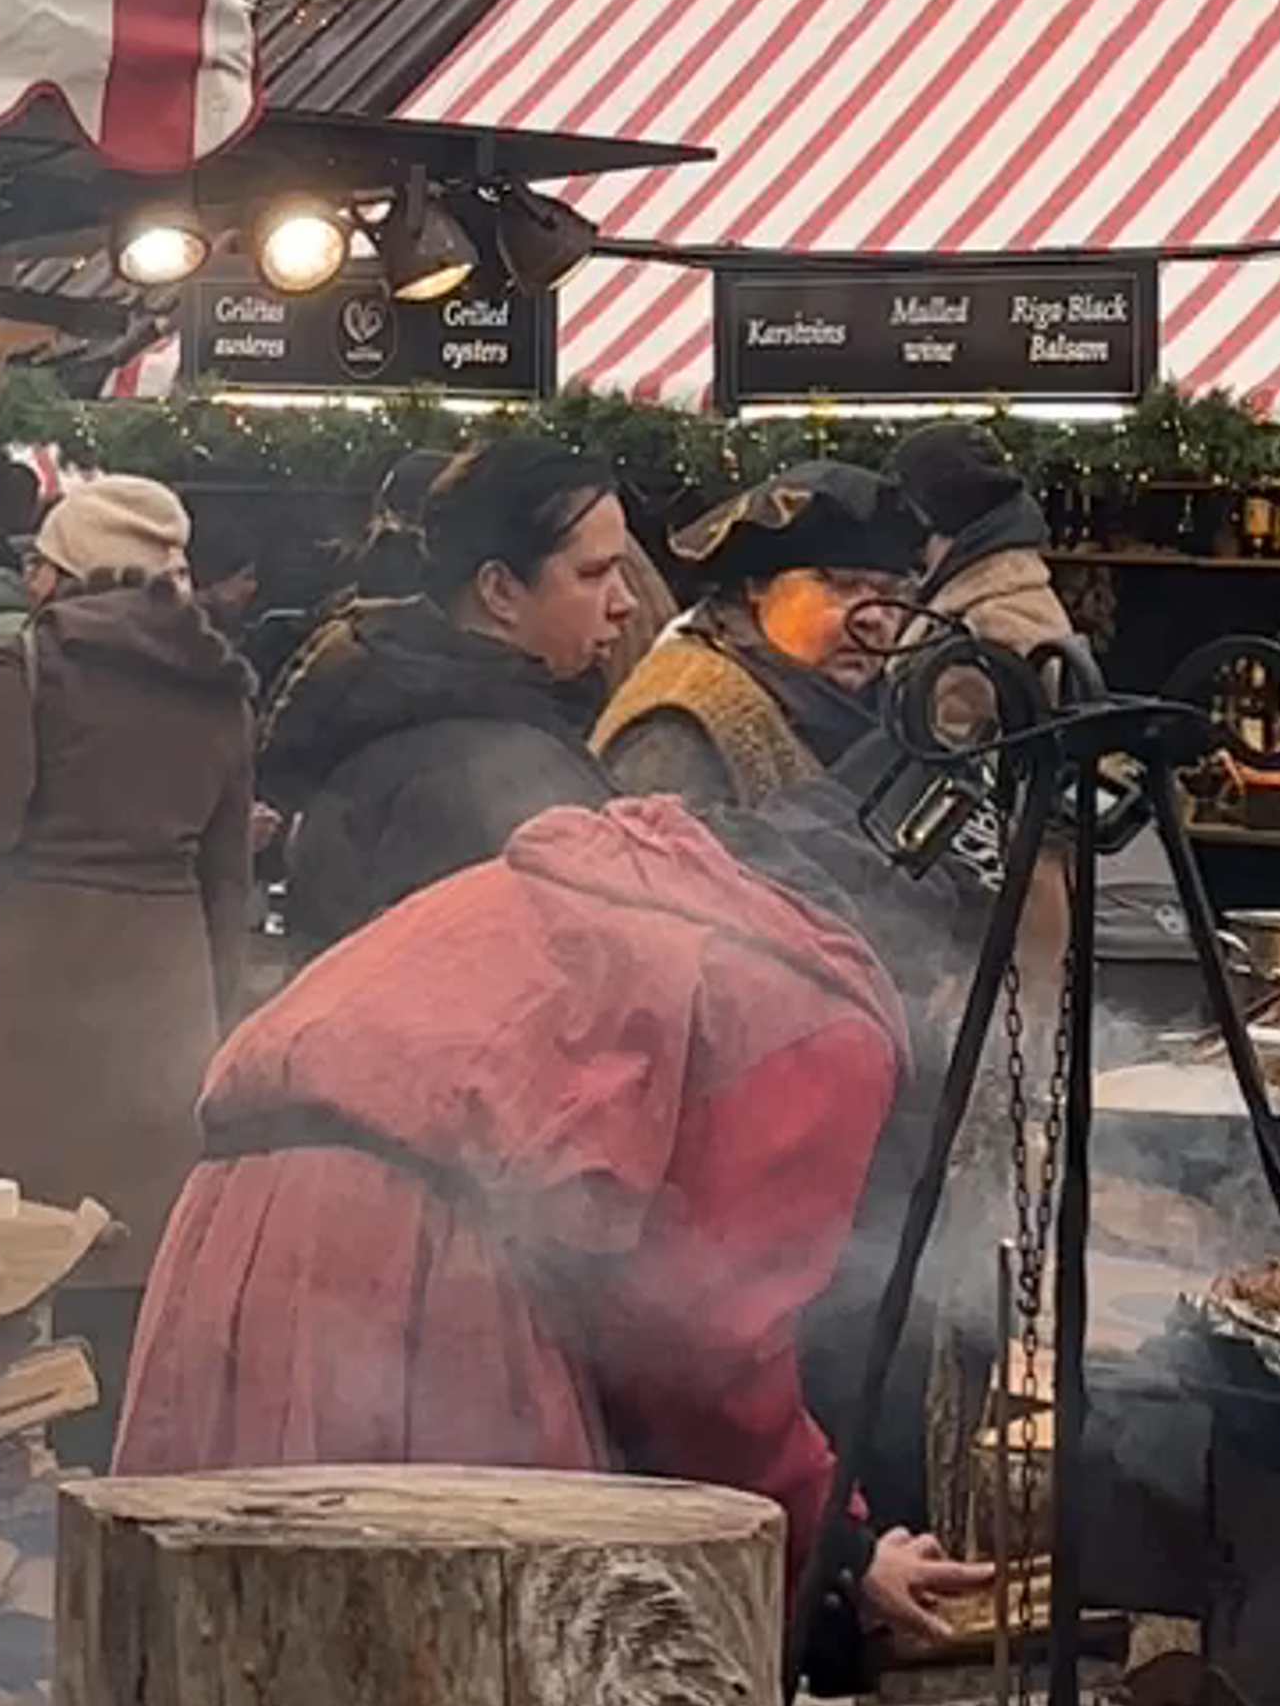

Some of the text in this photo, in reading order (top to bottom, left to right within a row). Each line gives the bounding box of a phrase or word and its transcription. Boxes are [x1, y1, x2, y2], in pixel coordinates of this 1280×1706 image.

[442, 299, 509, 326] Grilled
[889, 296, 971, 325] Mulled
[1010, 293, 1128, 330] Riga Black
[442, 339, 508, 370] oysters
[904, 336, 956, 362] wine
[1028, 333, 1109, 362] Balsam
